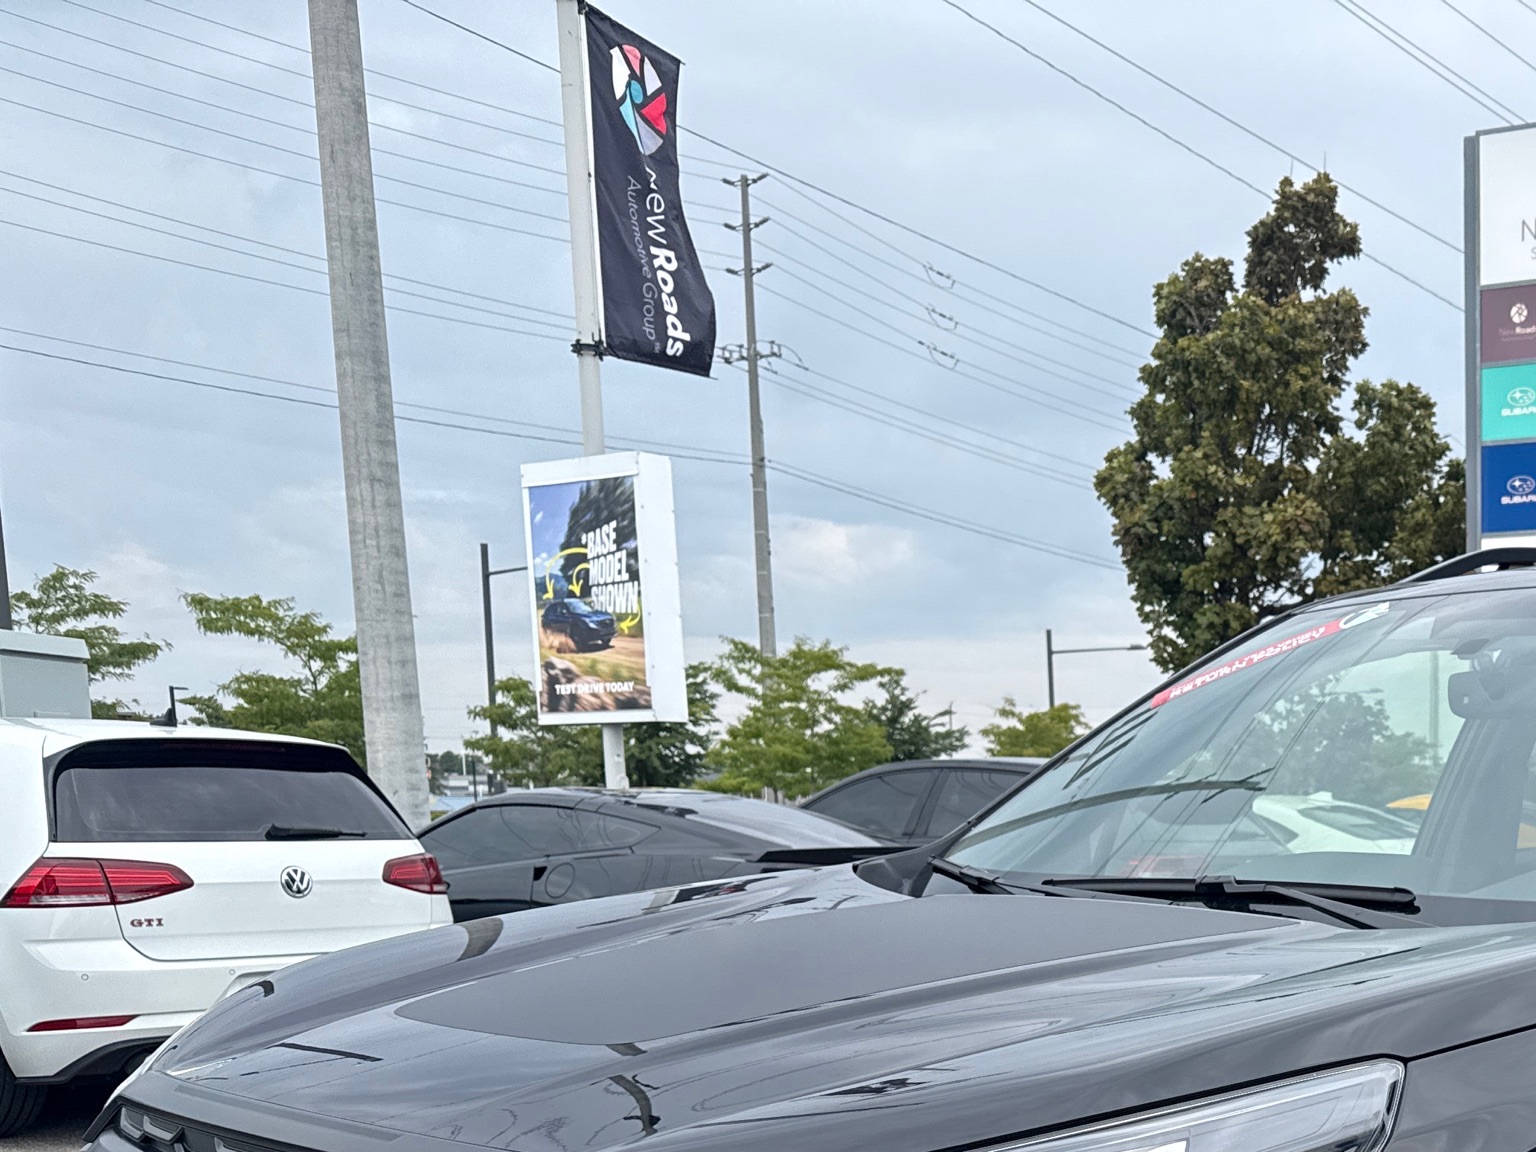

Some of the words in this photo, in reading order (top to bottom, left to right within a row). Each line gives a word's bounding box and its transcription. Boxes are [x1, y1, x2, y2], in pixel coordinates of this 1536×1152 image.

[628, 175, 652, 278] Automotive
[642, 282, 657, 341] Group
[589, 549, 629, 586] MODEL
[591, 581, 639, 614] SHOWN
[555, 684, 576, 695] TEST
[577, 683, 604, 695] DRIVE
[605, 681, 634, 693] TODAY
[130, 918, 164, 927] GTI
